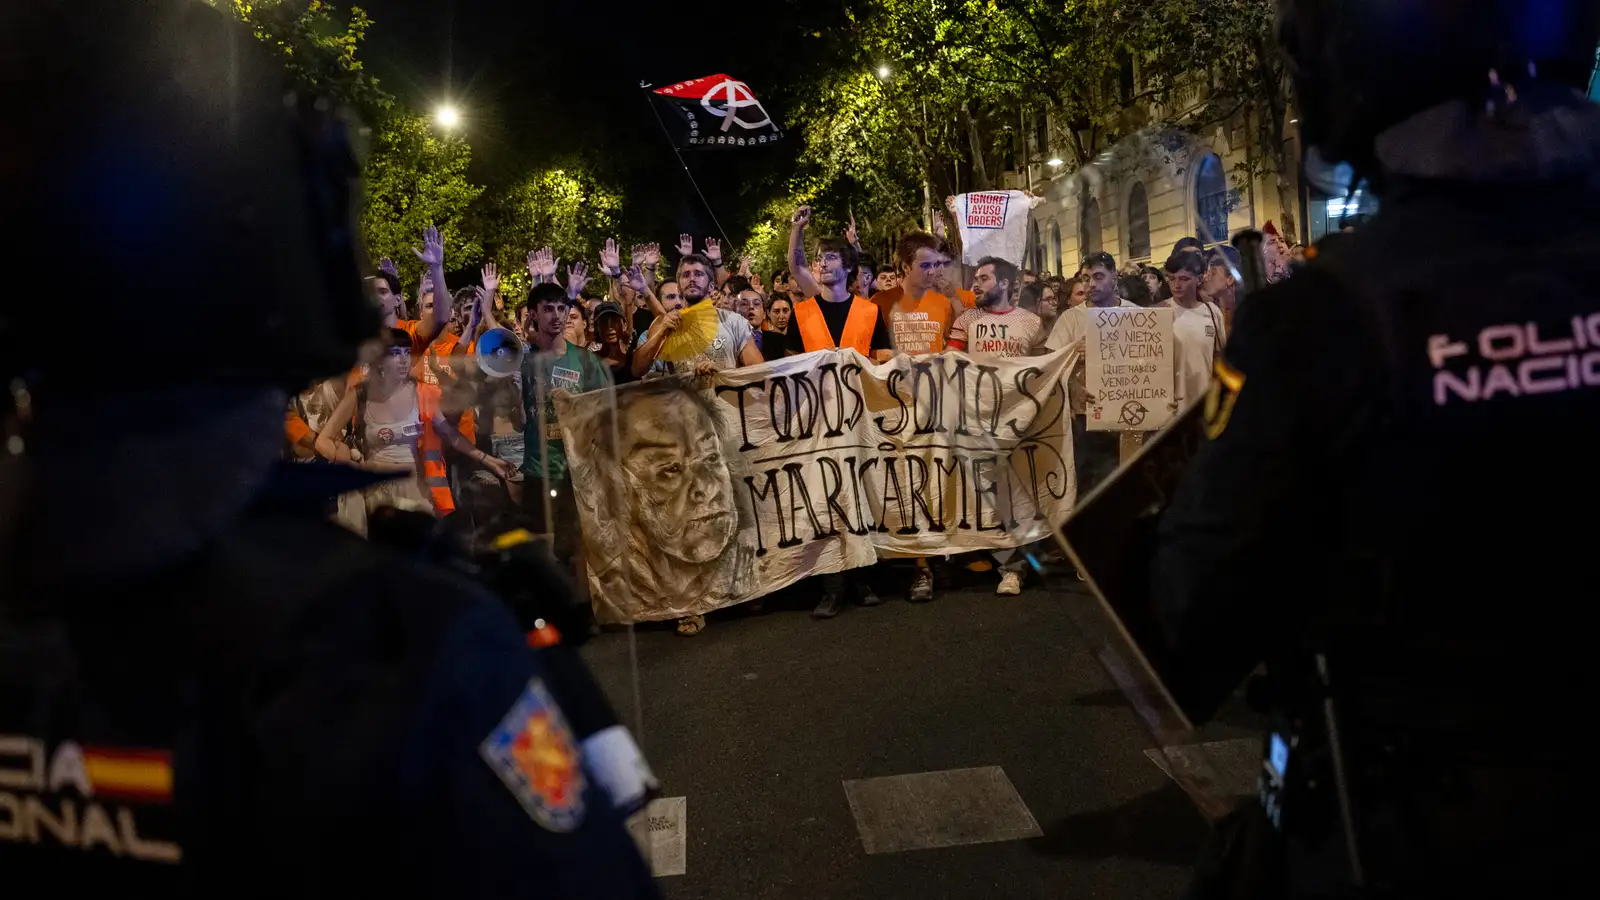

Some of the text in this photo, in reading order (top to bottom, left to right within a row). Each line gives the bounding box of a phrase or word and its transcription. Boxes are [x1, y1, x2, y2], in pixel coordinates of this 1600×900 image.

[970, 193, 1006, 205] IGNORE
[971, 204, 1001, 215] AYUSO
[967, 215, 1003, 226] ORDERS
[1096, 310, 1157, 329] SOMOS
[976, 323, 1009, 339] MST
[1100, 330, 1162, 344] LXS NIETXS
[1100, 342, 1116, 352] DE
[1101, 343, 1164, 360] LA VECINA
[1103, 362, 1157, 375] QUE HABÉIS
[1101, 374, 1151, 388] VENIDO A
[1099, 388, 1167, 402] DESAHUCIAR
[715, 358, 1066, 452] TODOS SOMOS
